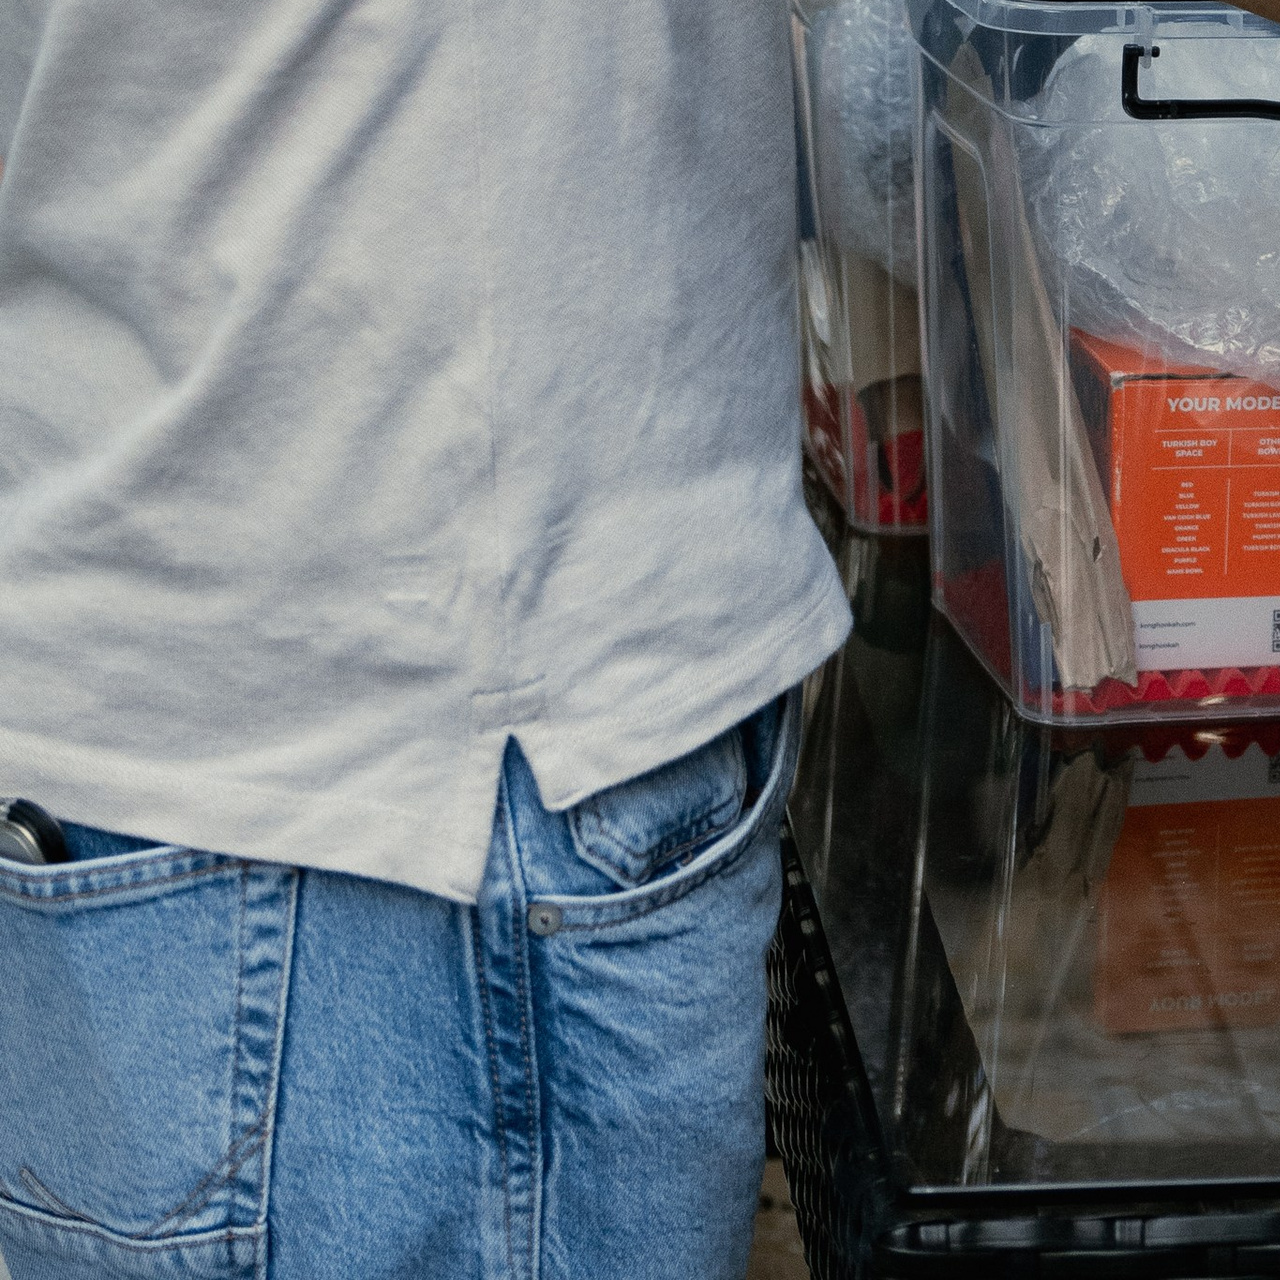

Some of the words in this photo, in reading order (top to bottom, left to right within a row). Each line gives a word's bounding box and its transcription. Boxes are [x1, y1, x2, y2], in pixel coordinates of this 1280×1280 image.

[1167, 397, 1221, 412] YOUR
[1162, 439, 1199, 448] TURKISH
[1199, 439, 1218, 447] BOY
[1175, 449, 1203, 457] SPACE
[1140, 621, 1196, 629] konghookah.com
[1139, 642, 1180, 650] konghookah
